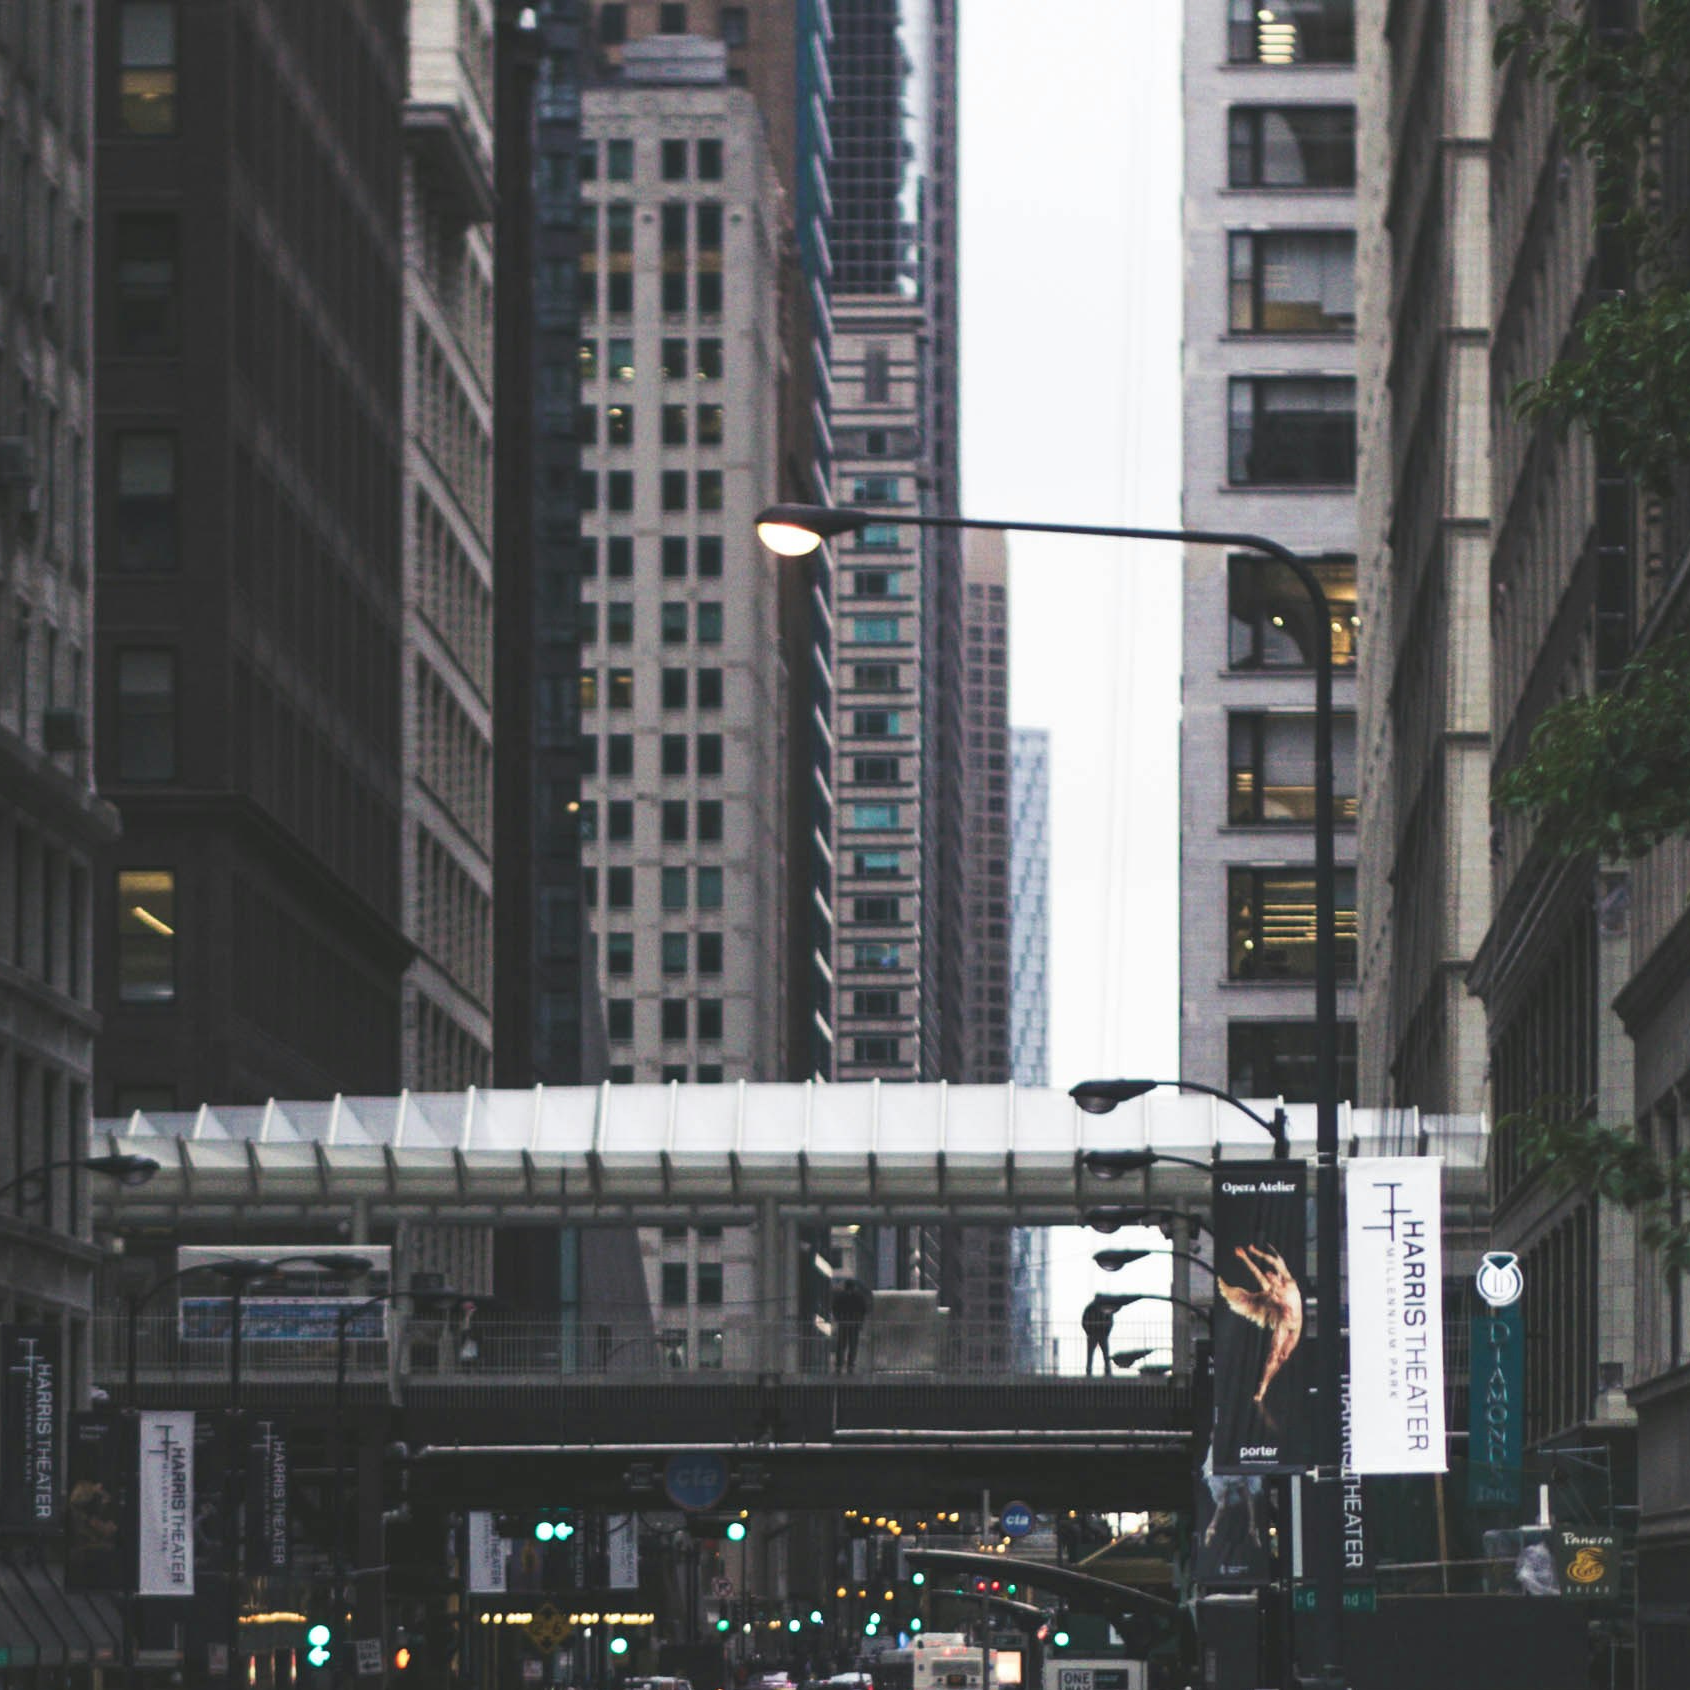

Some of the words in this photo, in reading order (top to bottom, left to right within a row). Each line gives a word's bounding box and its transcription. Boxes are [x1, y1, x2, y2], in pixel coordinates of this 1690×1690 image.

[1222, 1182, 1256, 1194] Opera
[1259, 1181, 1296, 1193] Atelier
[1385, 1247, 1398, 1349] MILLENNIUM
[1403, 1220, 1427, 1327] HARRIS
[36, 1363, 52, 1435] HARRIS
[1388, 1358, 1398, 1399] PARK
[1405, 1334, 1430, 1452] THEATER
[35, 1440, 52, 1517] THEATER
[171, 1447, 186, 1510] HARRIS
[273, 1441, 285, 1499] HARRIS
[1240, 1445, 1278, 1458] porter
[171, 1515, 186, 1584] THEATER
[273, 1503, 286, 1565] THEATER
[1561, 1531, 1613, 1544] Panera
[1064, 1672, 1090, 1684] ONE
